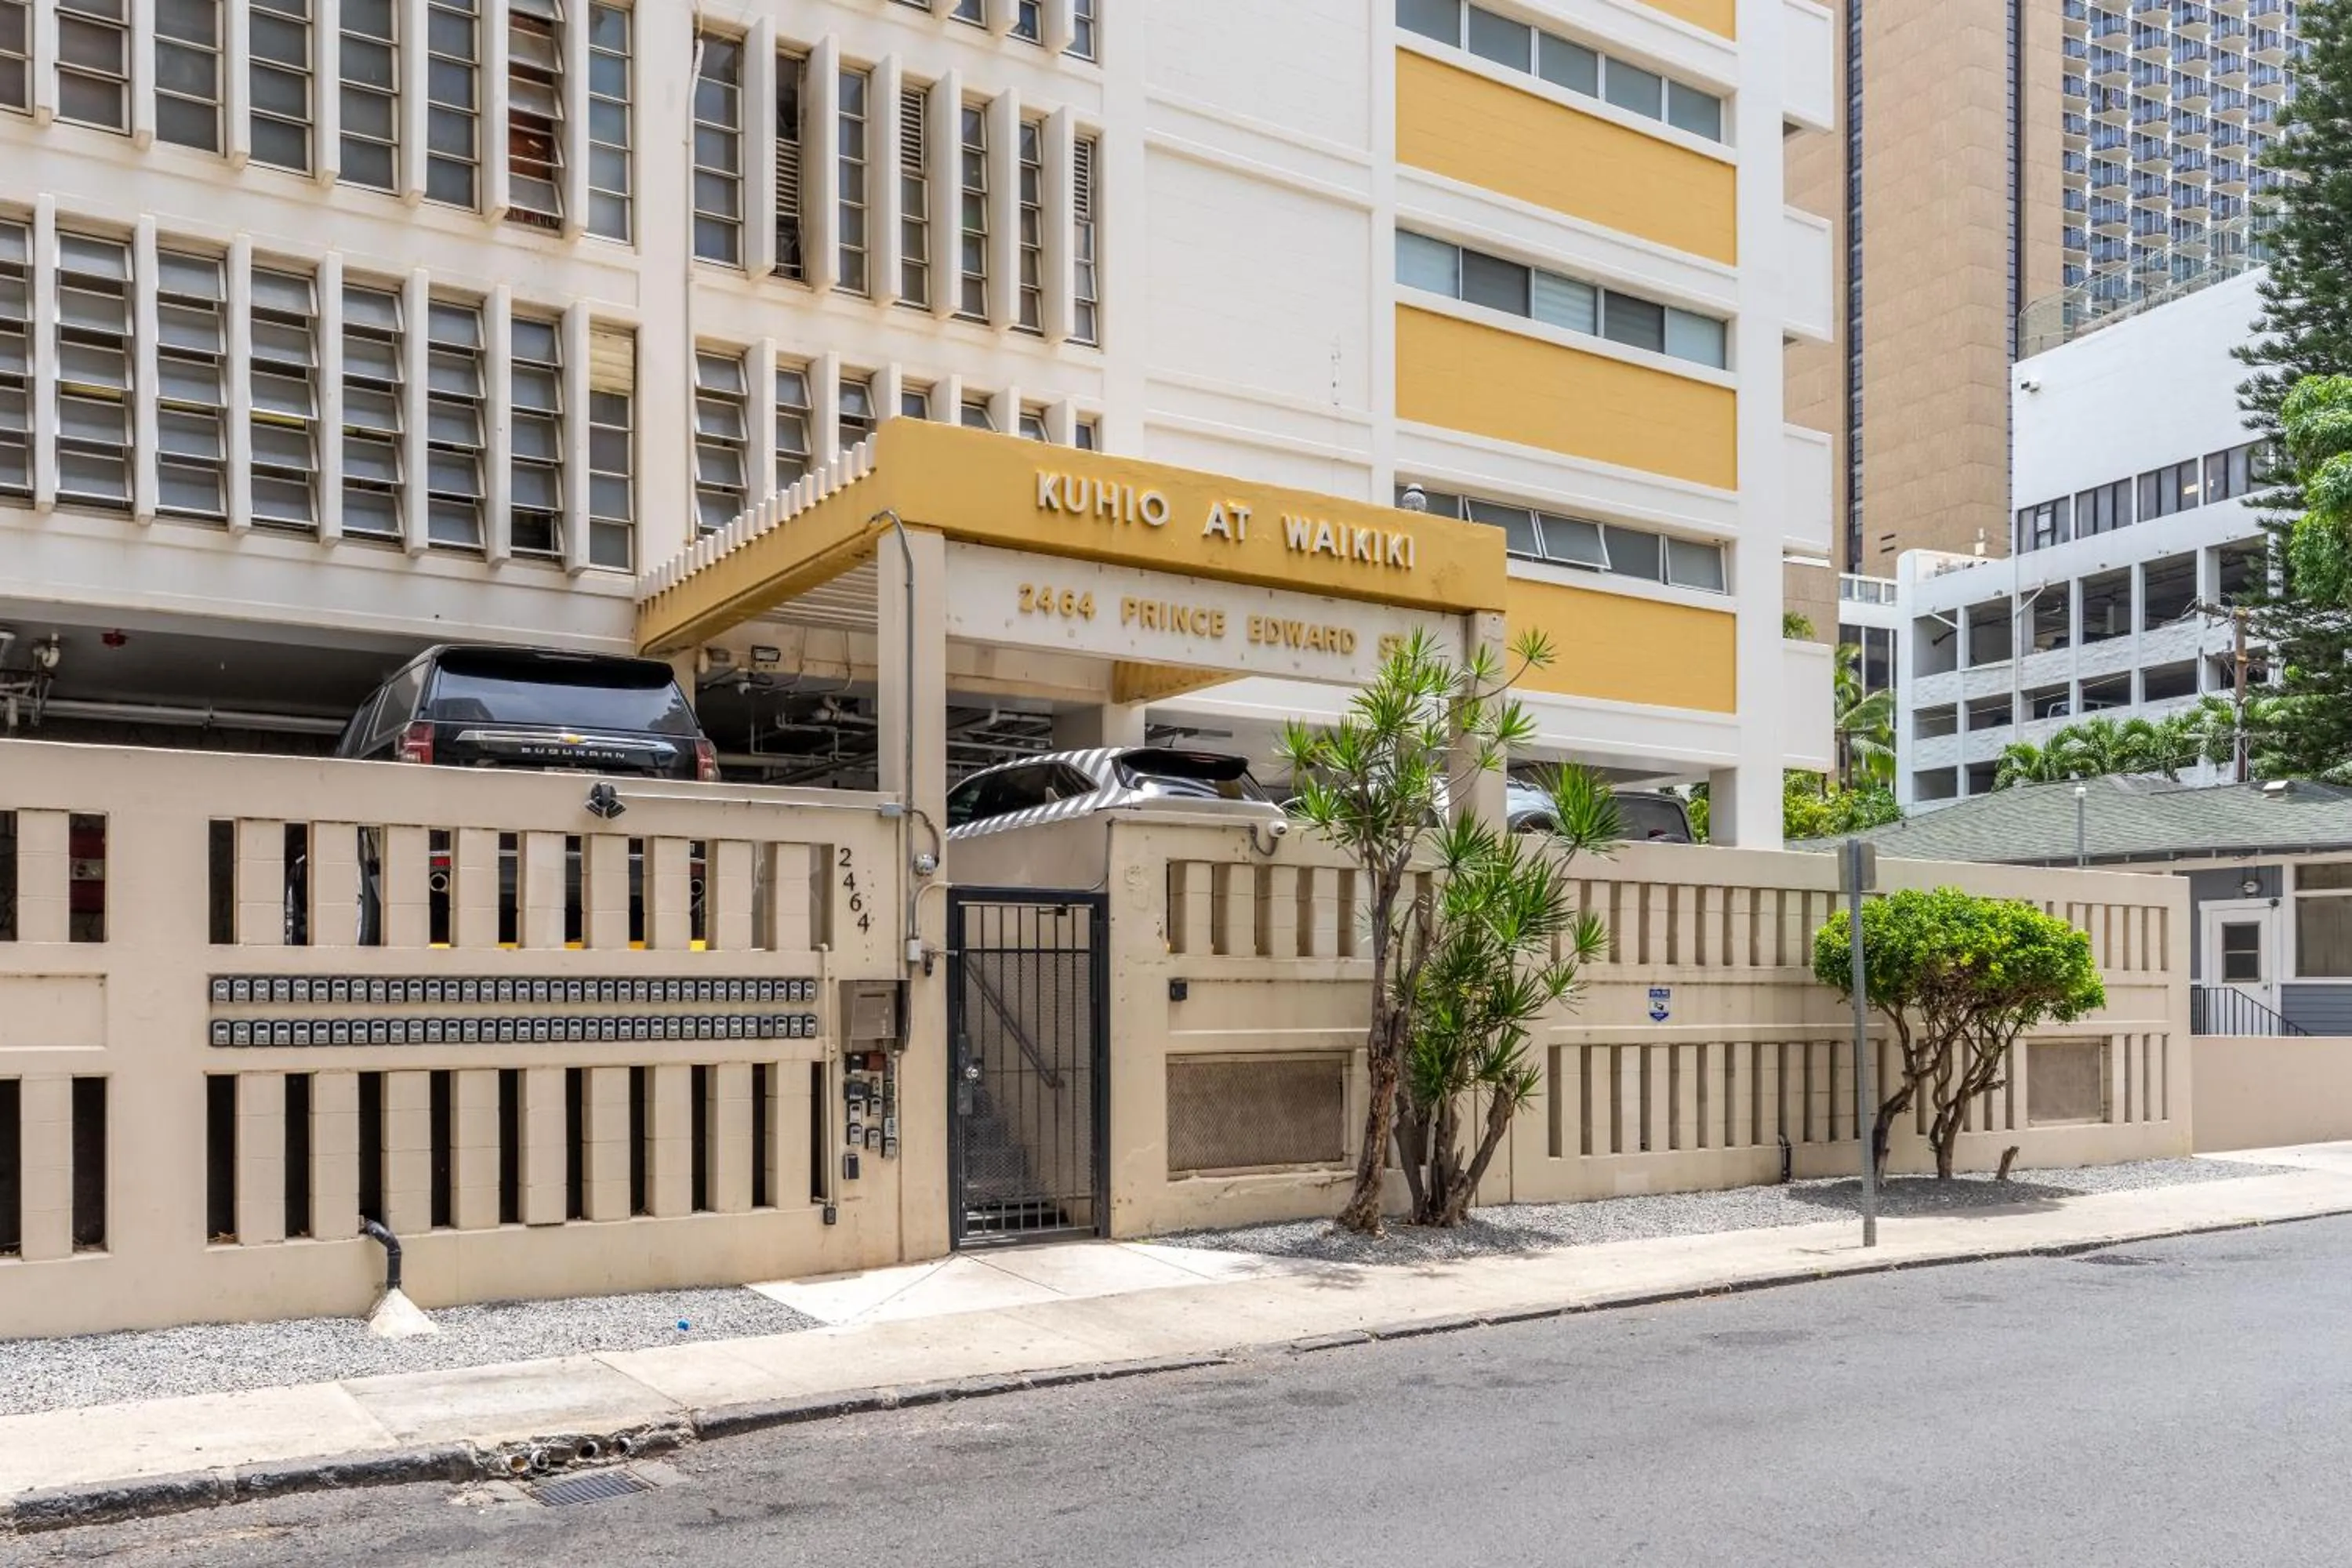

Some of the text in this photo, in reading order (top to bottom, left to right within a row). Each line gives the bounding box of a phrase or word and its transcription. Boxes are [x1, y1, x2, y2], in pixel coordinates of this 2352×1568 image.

[1036, 470, 1414, 569] KUHIO AT WAIKIKI
[1018, 583, 1095, 622] 2464
[1120, 597, 1225, 637] PRINCE
[1247, 614, 1357, 656] EDWARD
[839, 848, 870, 935] 2464
